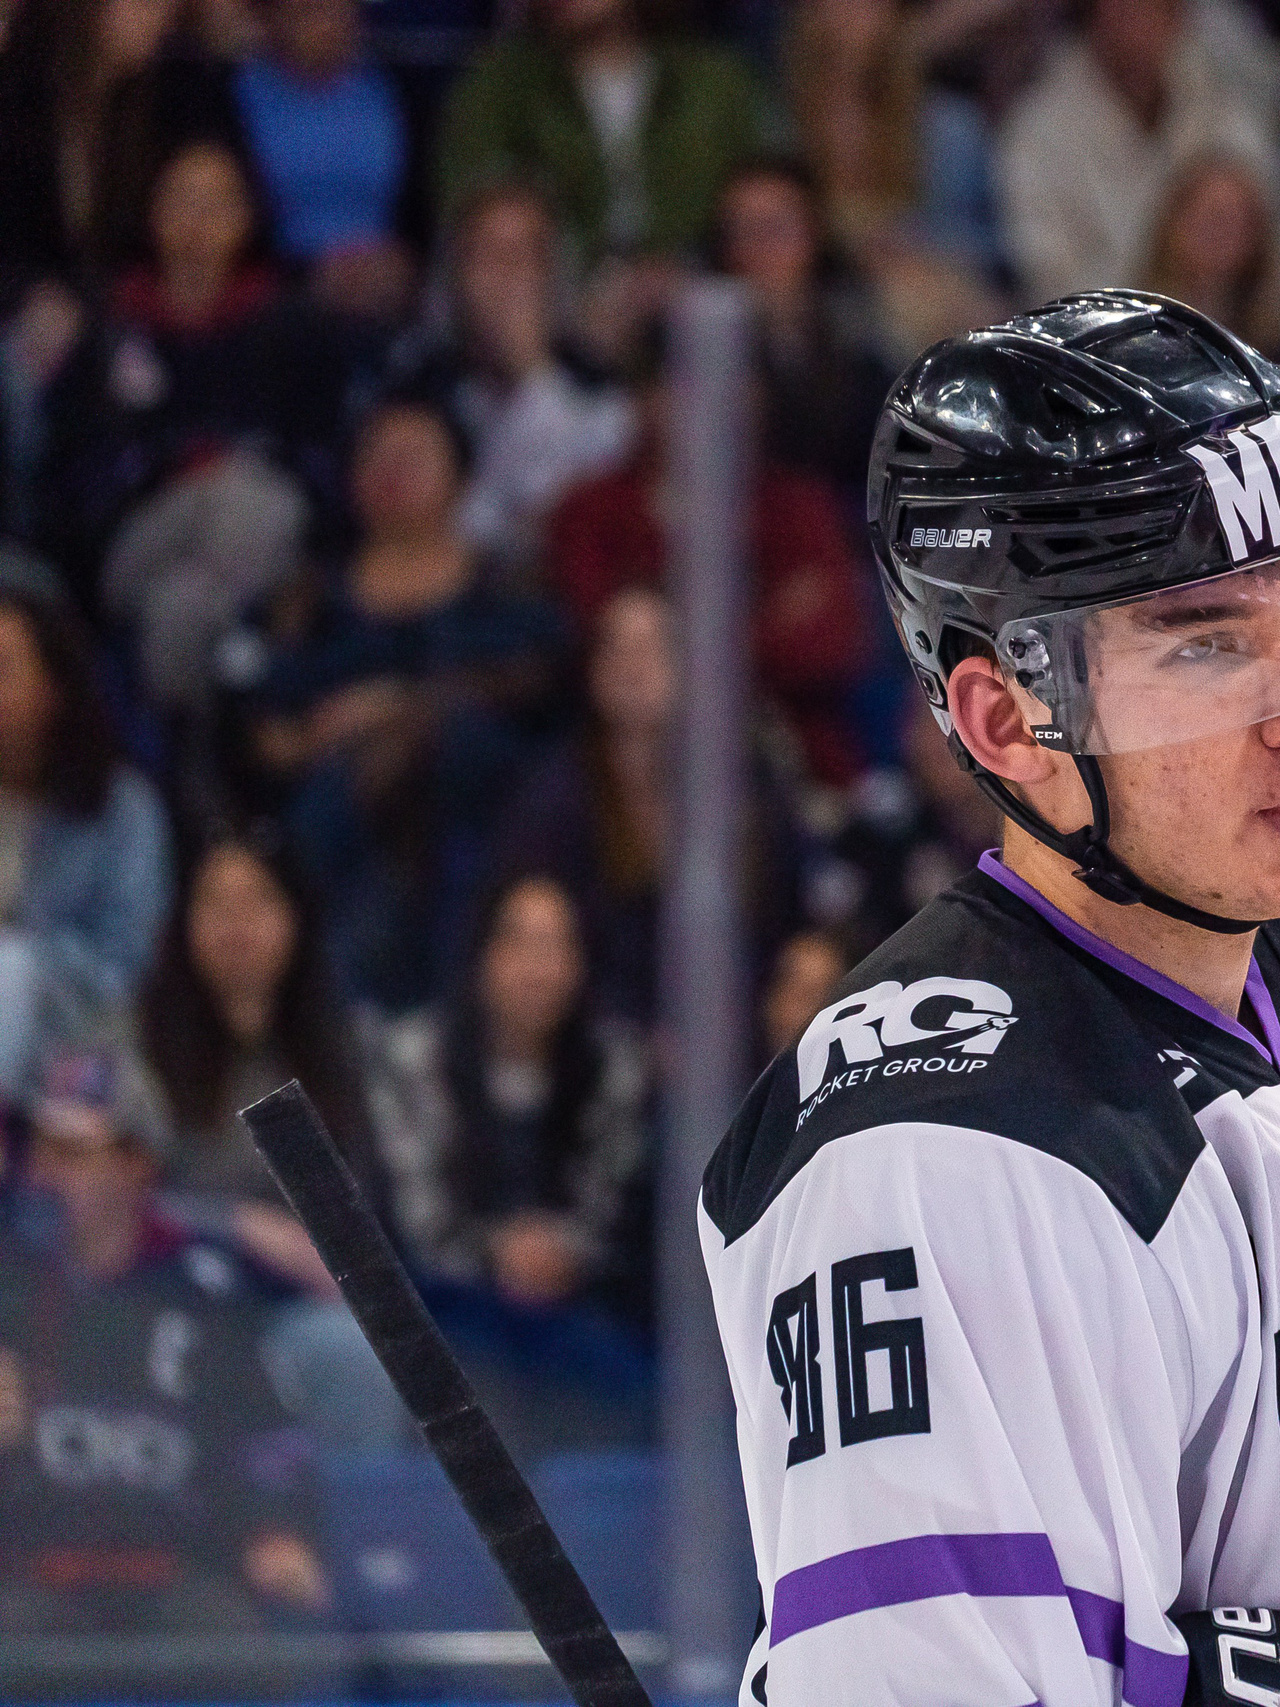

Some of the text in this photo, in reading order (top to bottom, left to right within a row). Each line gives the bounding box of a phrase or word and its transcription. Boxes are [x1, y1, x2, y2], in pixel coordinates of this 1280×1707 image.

[1035, 731, 1063, 740] CCM
[797, 976, 1014, 1104] RG
[795, 1057, 988, 1132] ROCKET GROUP
